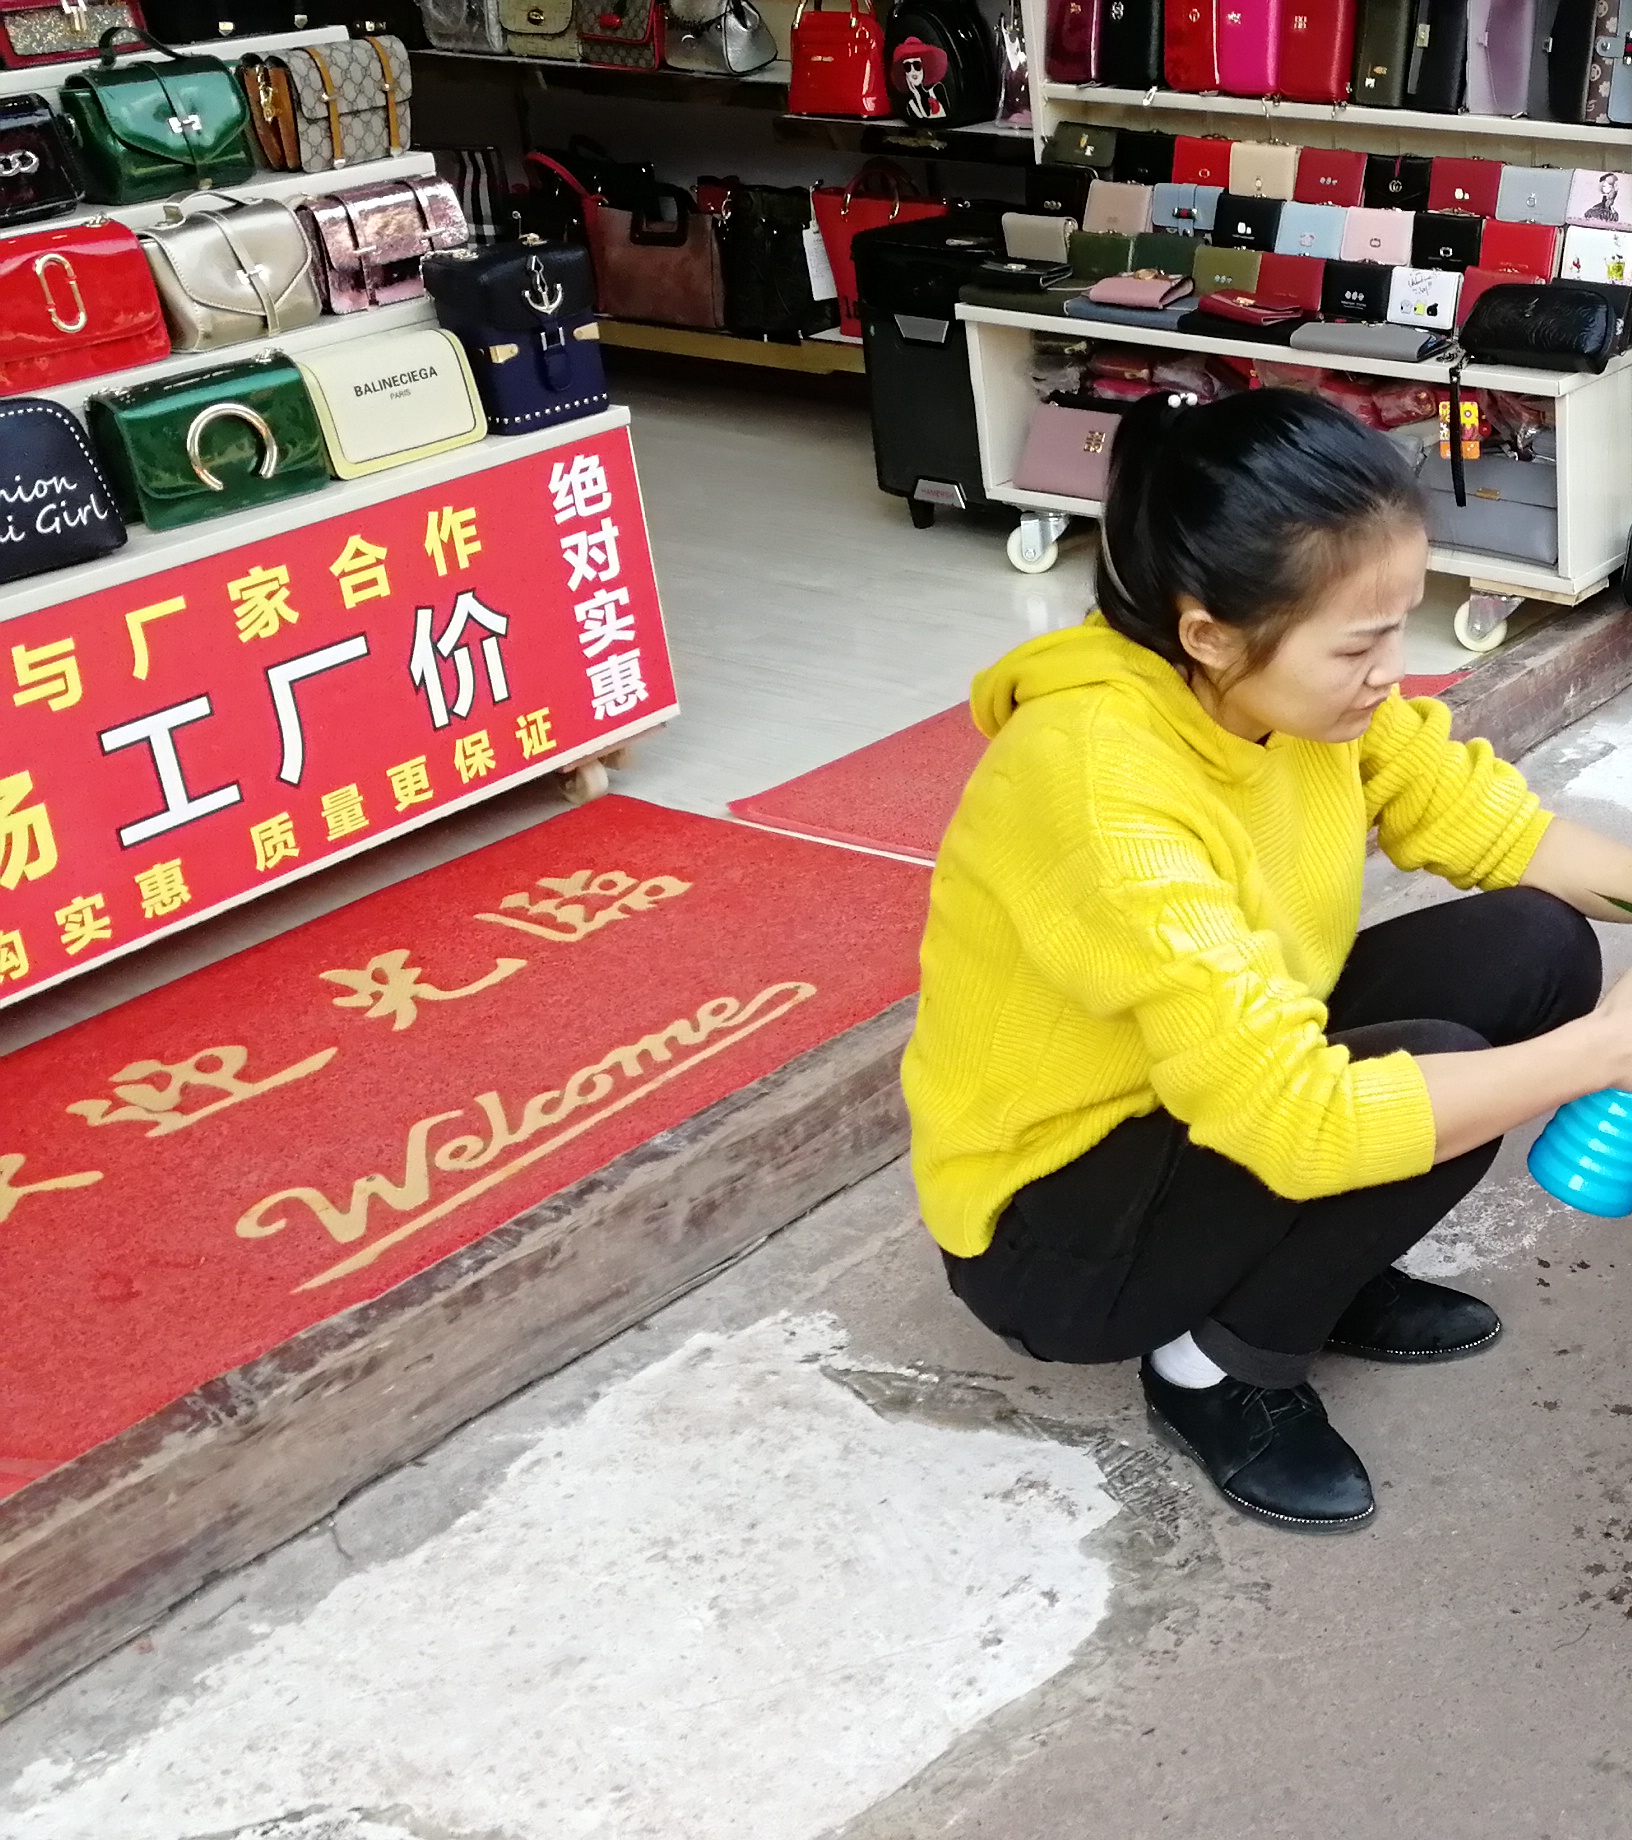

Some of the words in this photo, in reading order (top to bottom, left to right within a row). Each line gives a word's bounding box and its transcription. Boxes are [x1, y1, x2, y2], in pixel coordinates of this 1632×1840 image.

[353, 366, 438, 397] BALINECIEGA
[389, 388, 412, 400] PARIS
[36, 493, 109, 534] Girl
[547, 453, 650, 720] 绝对实惠
[11, 505, 483, 712] 与厂家合作
[100, 589, 509, 850] 工厂价
[250, 707, 557, 871] 质量更保证
[235, 980, 817, 1243] Welcome
